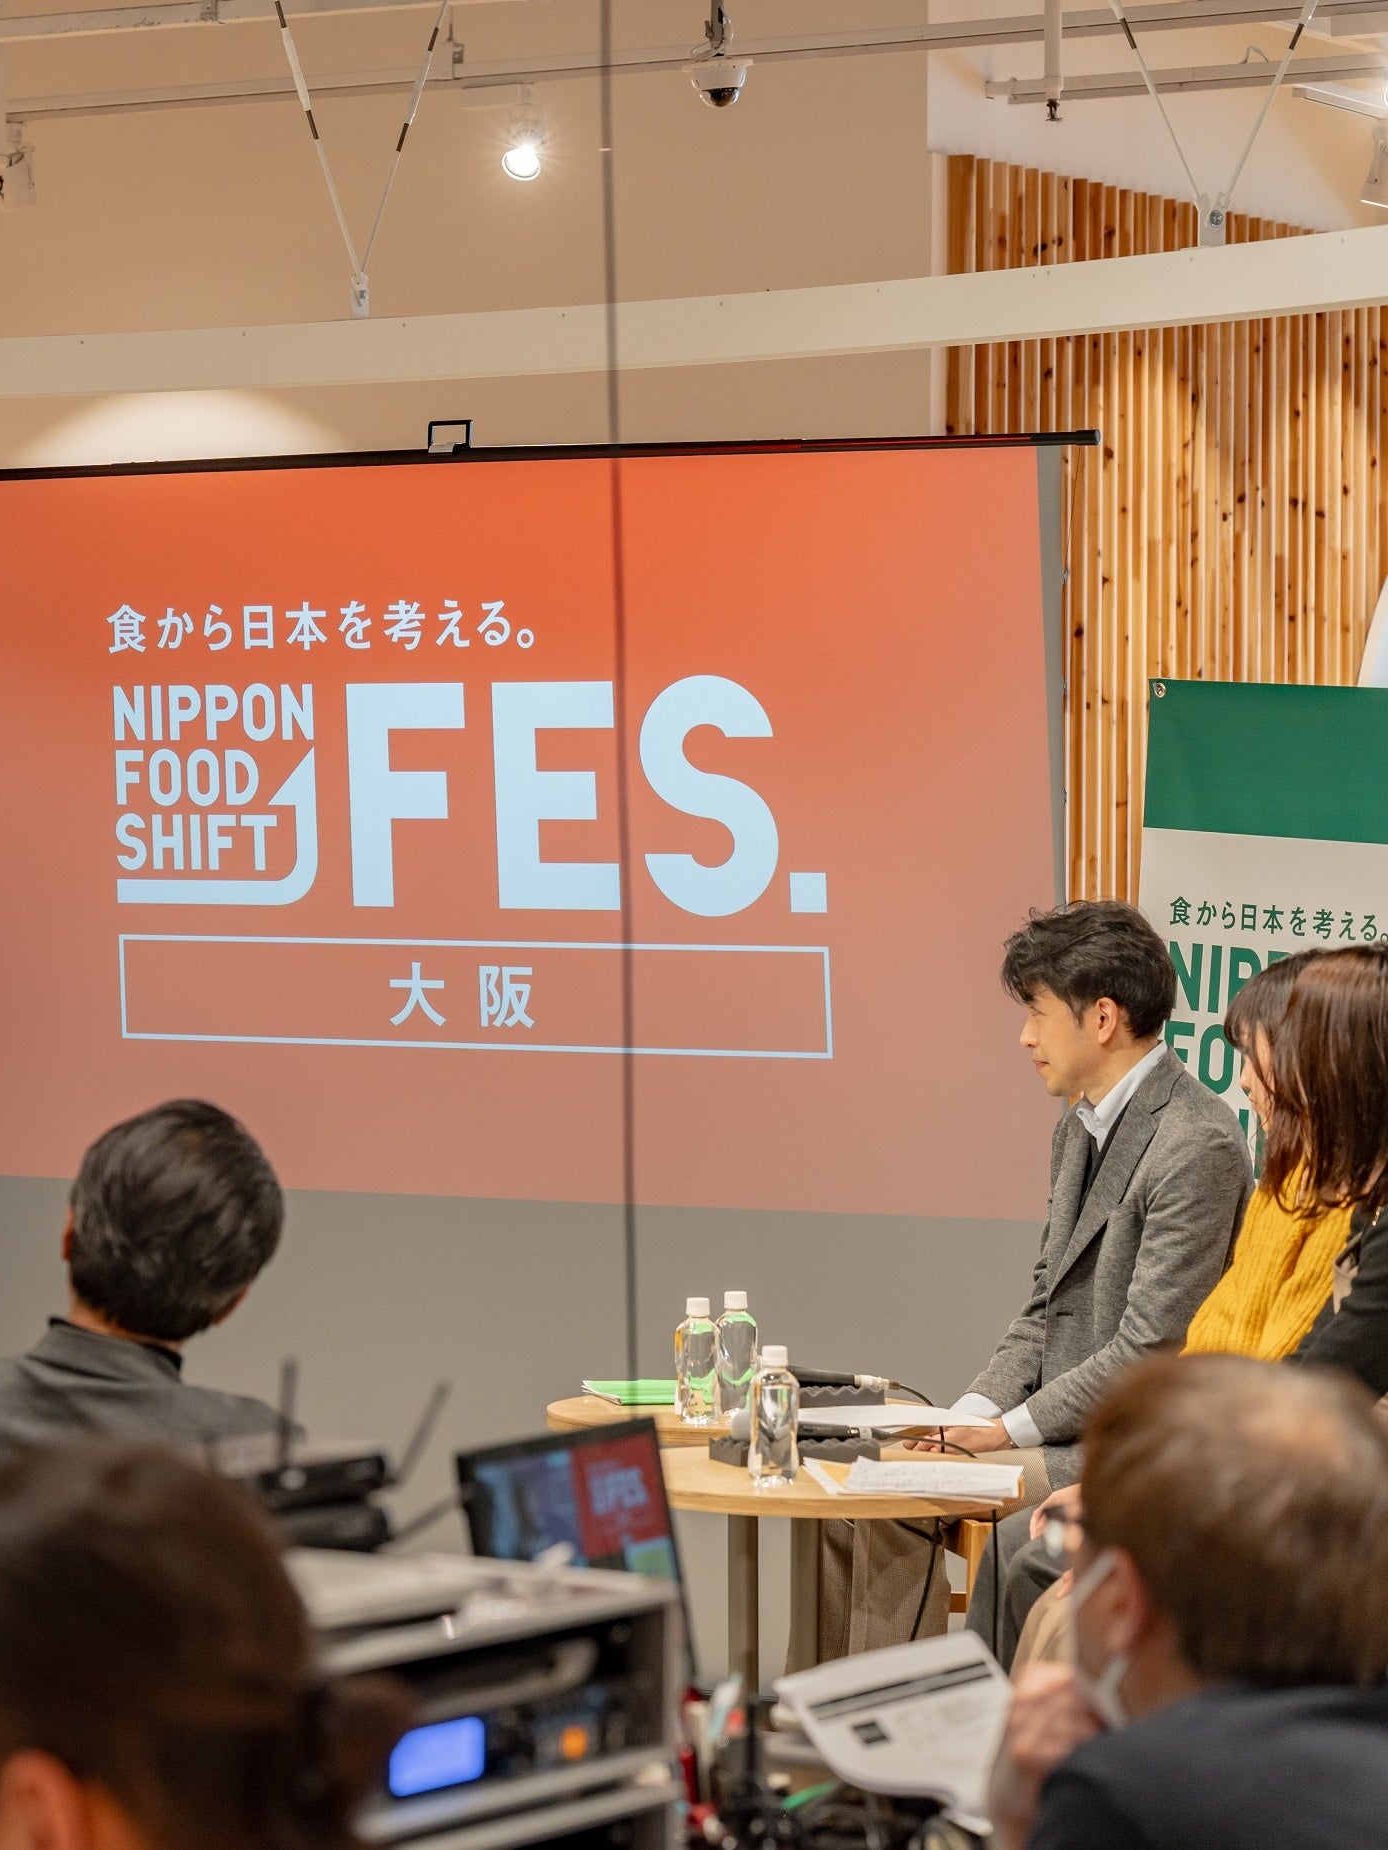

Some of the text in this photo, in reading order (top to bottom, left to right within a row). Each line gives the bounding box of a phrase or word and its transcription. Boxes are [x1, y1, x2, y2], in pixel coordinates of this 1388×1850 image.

[106, 599, 535, 653] 食から日本を考える。
[112, 682, 315, 742] NIPPON
[115, 748, 260, 807] FOOD
[345, 674, 828, 918] FES.
[115, 812, 278, 871] SHIFT
[1169, 896, 1388, 945] 食から日本を考える。
[389, 961, 535, 1030] 大阪
